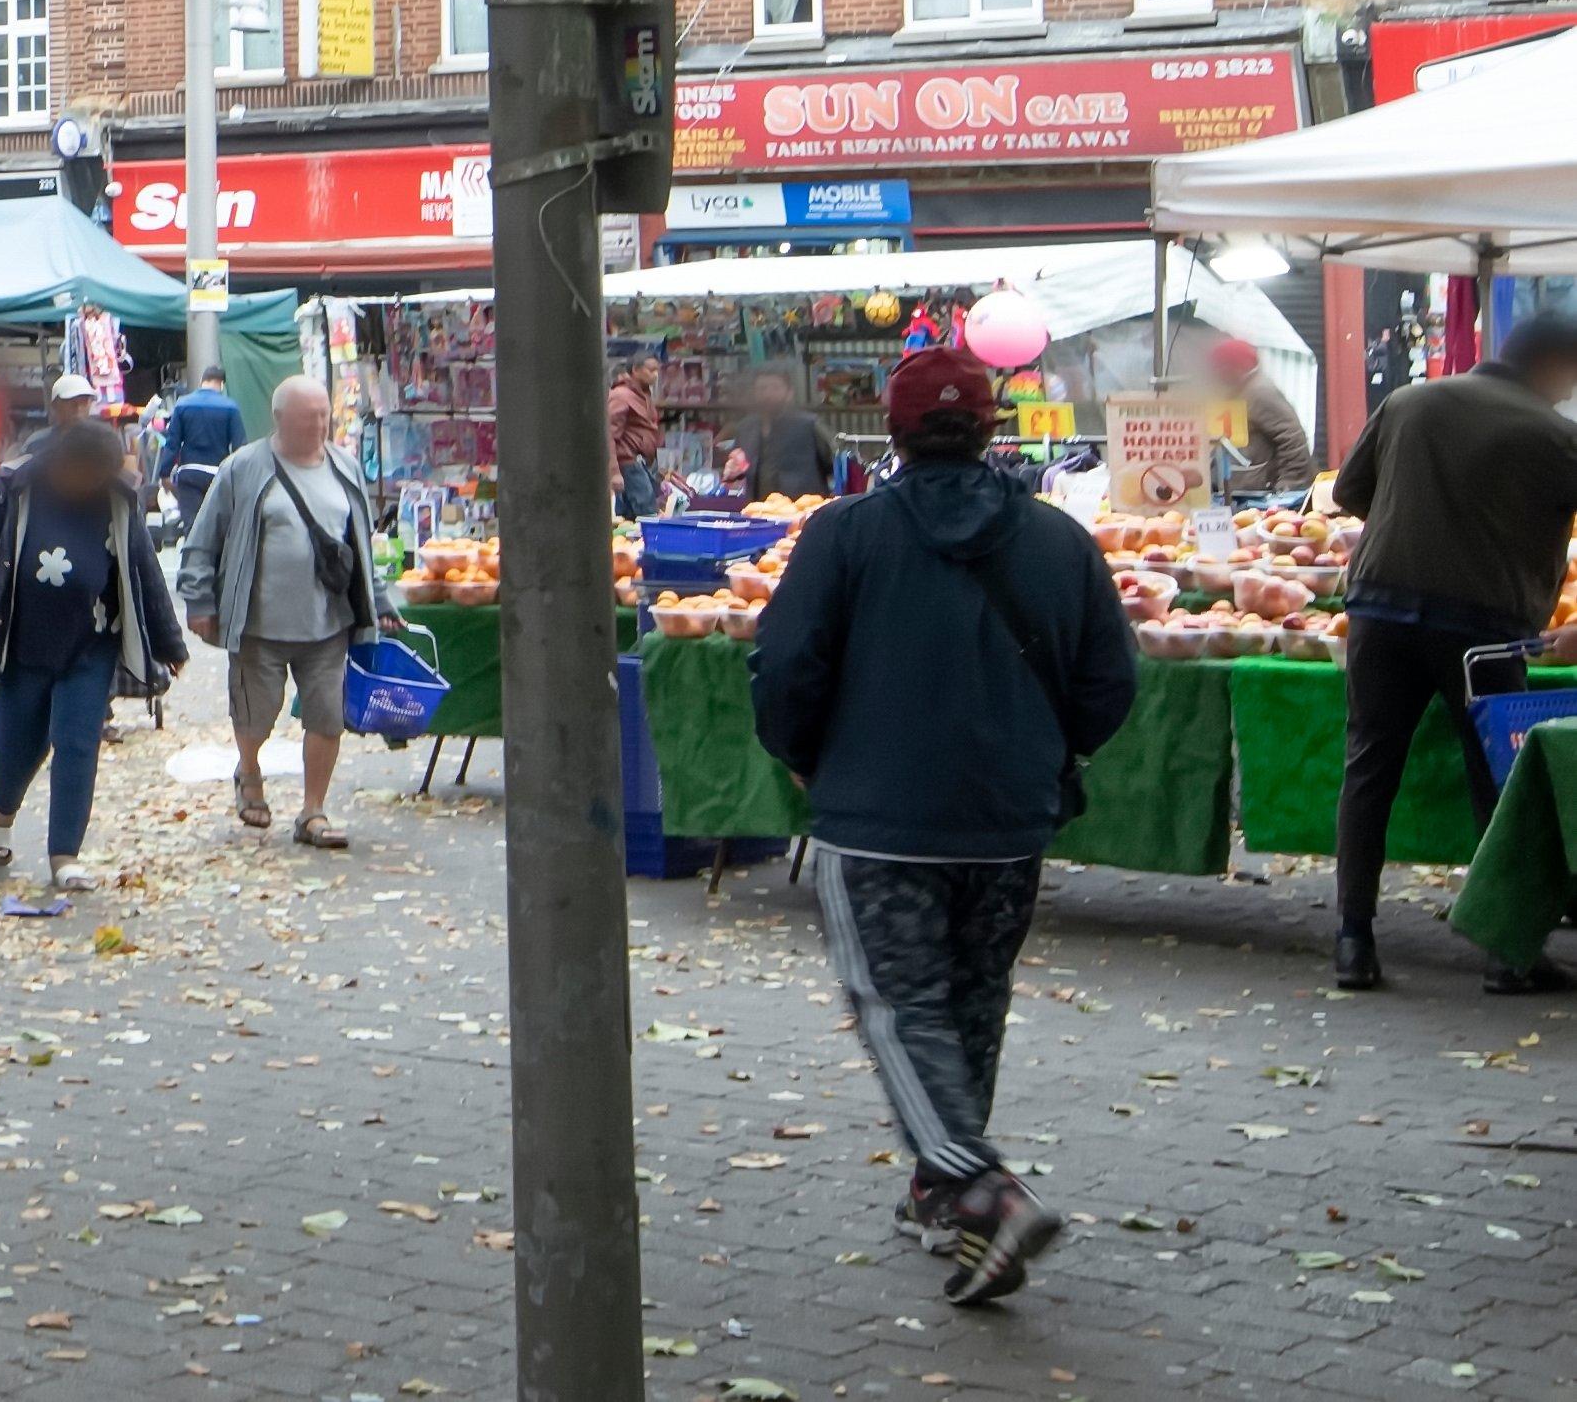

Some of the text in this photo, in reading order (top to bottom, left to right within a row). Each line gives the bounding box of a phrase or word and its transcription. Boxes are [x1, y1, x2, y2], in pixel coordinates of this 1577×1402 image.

[675, 103, 722, 121] OOD
[763, 74, 1129, 137] SUN ON CAFE
[765, 140, 837, 158] FAMILY
[841, 134, 976, 156] RESTAURANT
[1003, 132, 1062, 150] TAKE
[1066, 129, 1131, 148] AWAY
[130, 179, 257, 231] Sn
[808, 182, 883, 204] MOBILE
